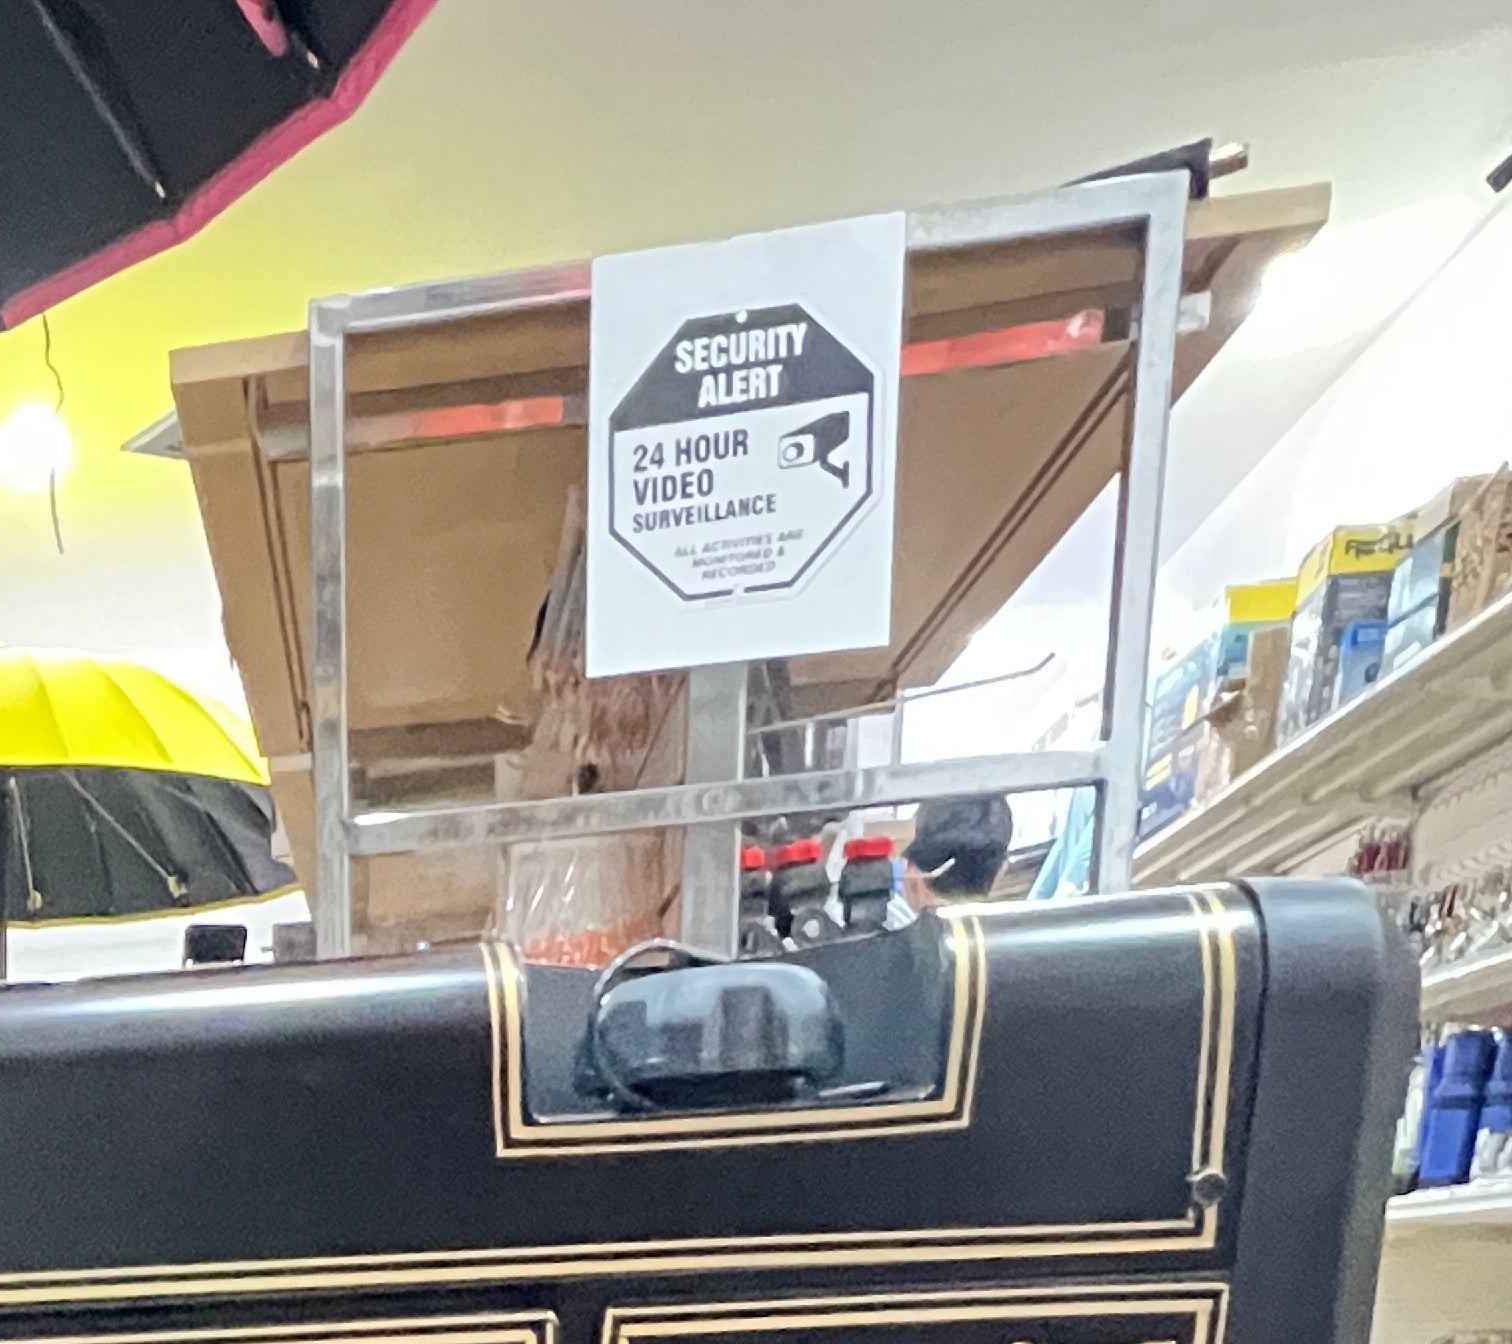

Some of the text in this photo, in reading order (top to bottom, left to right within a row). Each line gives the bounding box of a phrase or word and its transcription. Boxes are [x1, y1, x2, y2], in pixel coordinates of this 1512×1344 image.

[674, 322, 808, 374] SECURITY
[696, 364, 784, 409] ALERT
[632, 428, 749, 473] 24 HOUR
[632, 468, 714, 506] VIDEO
[632, 493, 778, 534] SURVEILLANCE
